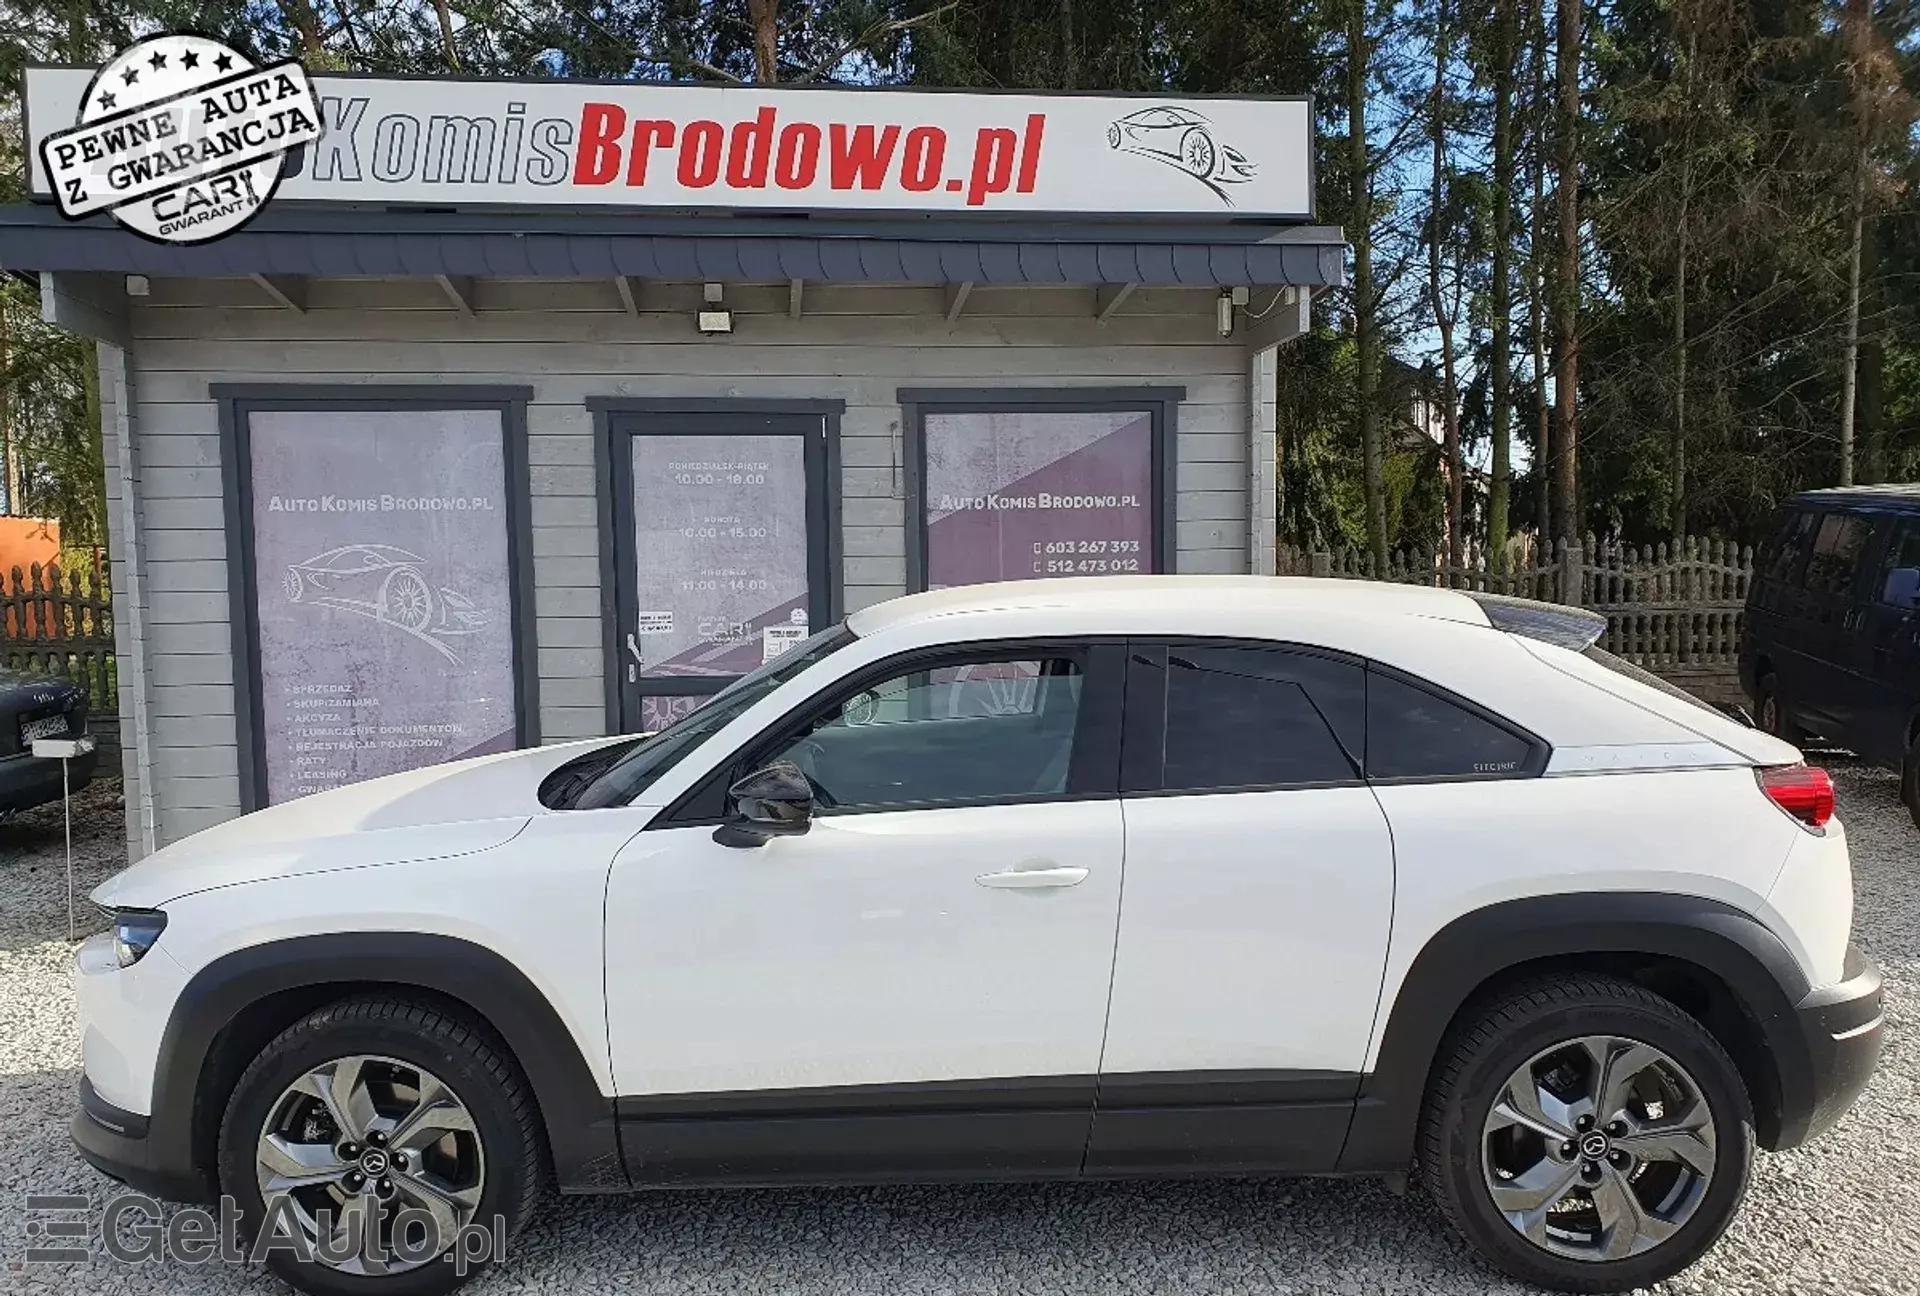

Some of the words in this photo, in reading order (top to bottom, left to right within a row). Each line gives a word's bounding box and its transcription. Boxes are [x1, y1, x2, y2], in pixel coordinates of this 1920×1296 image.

[675, 474, 714, 485] 10.00
[730, 527, 767, 538] 15.00
[1045, 541, 1076, 554] 603
[1077, 540, 1107, 553] 267
[1110, 540, 1140, 553] 393
[1046, 560, 1075, 573] 512
[1077, 560, 1106, 573] 473
[1110, 559, 1139, 572] 012
